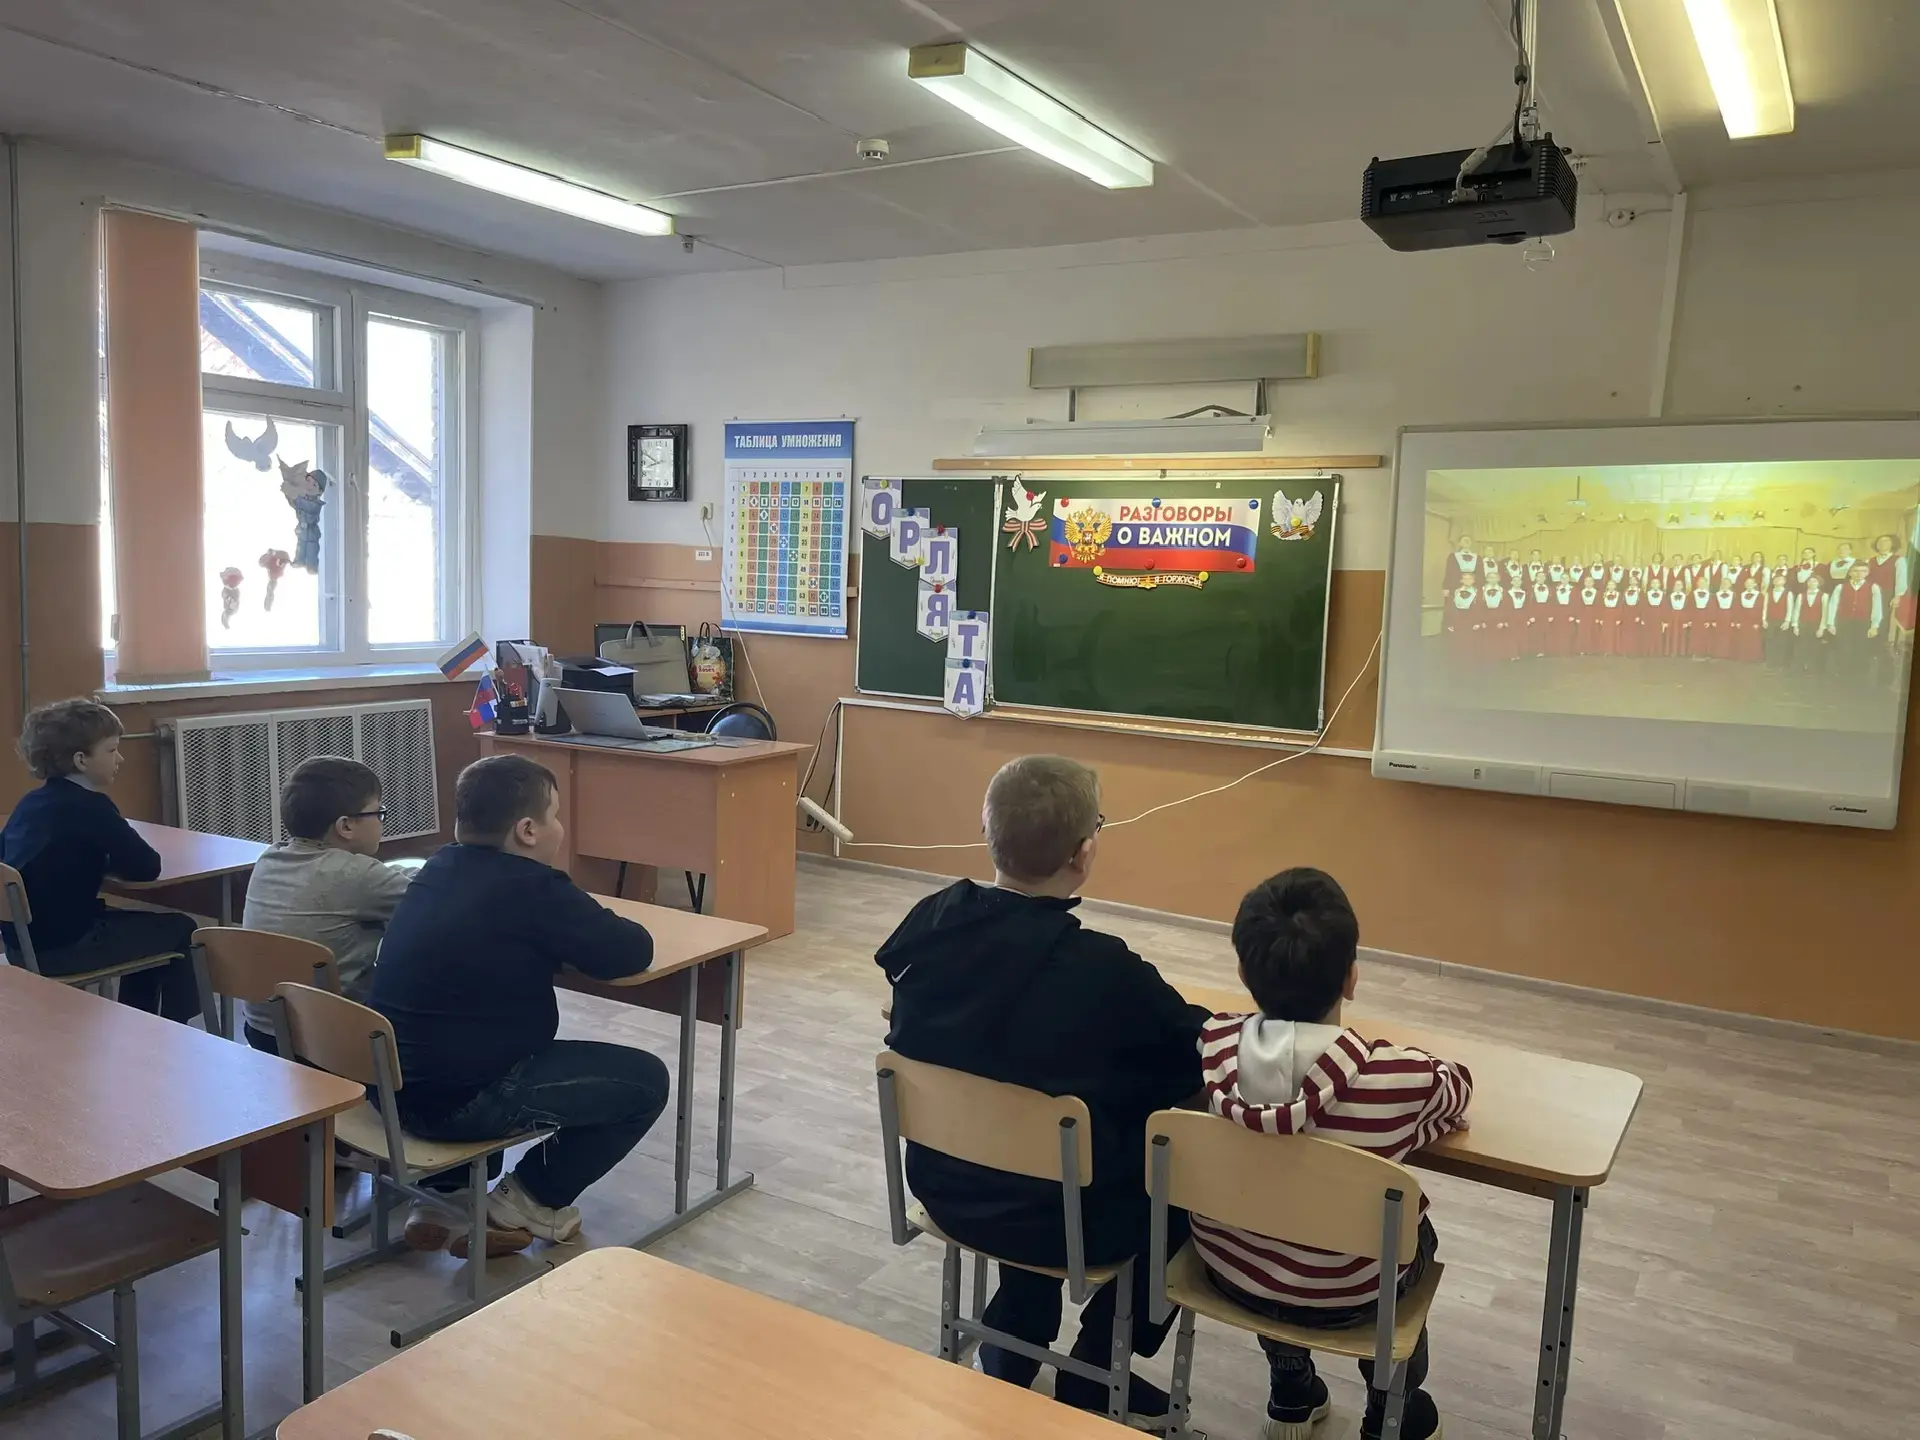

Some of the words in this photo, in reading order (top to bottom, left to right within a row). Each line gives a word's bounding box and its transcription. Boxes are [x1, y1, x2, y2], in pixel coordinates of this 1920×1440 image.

[734, 436, 778, 449] ТАБЛИЦА
[781, 434, 842, 448] УМНОЖЕНИЯ
[1119, 505, 1232, 522] РАЗГОВОРЫ
[1117, 527, 1132, 545] О
[1138, 527, 1232, 547] ВАЖНОМ
[1107, 575, 1140, 584] ПОМНЮ!
